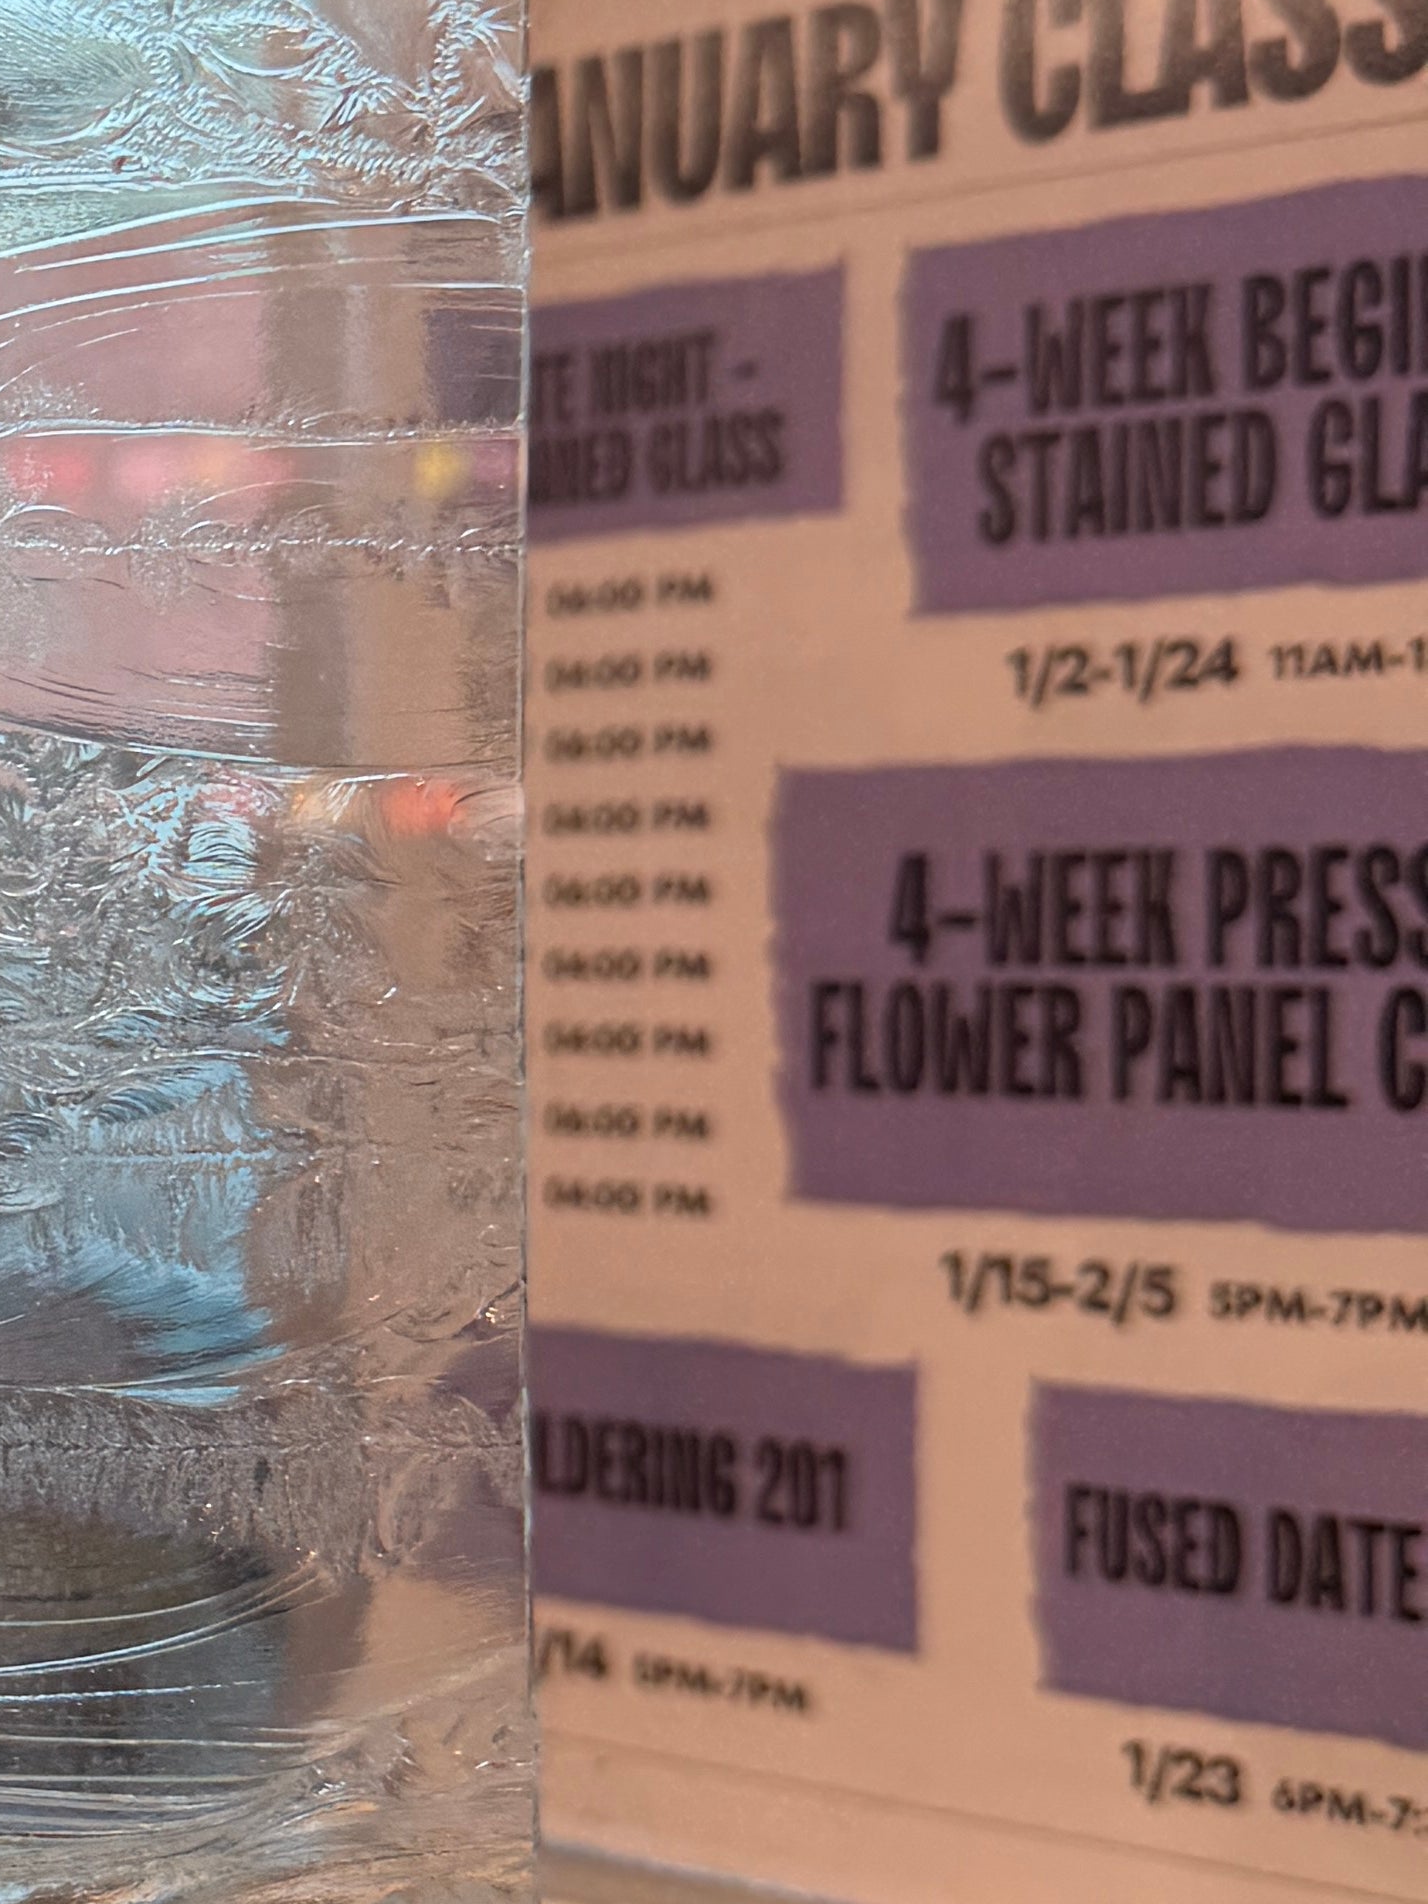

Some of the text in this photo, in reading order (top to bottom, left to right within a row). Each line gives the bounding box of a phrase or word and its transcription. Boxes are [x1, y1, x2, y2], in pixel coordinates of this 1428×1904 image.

[932, 252, 1428, 429] 4-WEEK BEGI
[645, 405, 785, 495] GLASS
[977, 407, 1278, 550] STAINED
[1006, 637, 1241, 708] 1/2-1/24
[888, 846, 1178, 969] 4-WEEK
[809, 980, 1085, 1104] FLOWER
[1111, 984, 1350, 1110] PANEL
[941, 1249, 1428, 1337] 1/15-2/5 5PM-7PM
[754, 1434, 847, 1533] 201
[1064, 1480, 1424, 1623] FUSED DATE
[1121, 1736, 1243, 1807] 1/23
